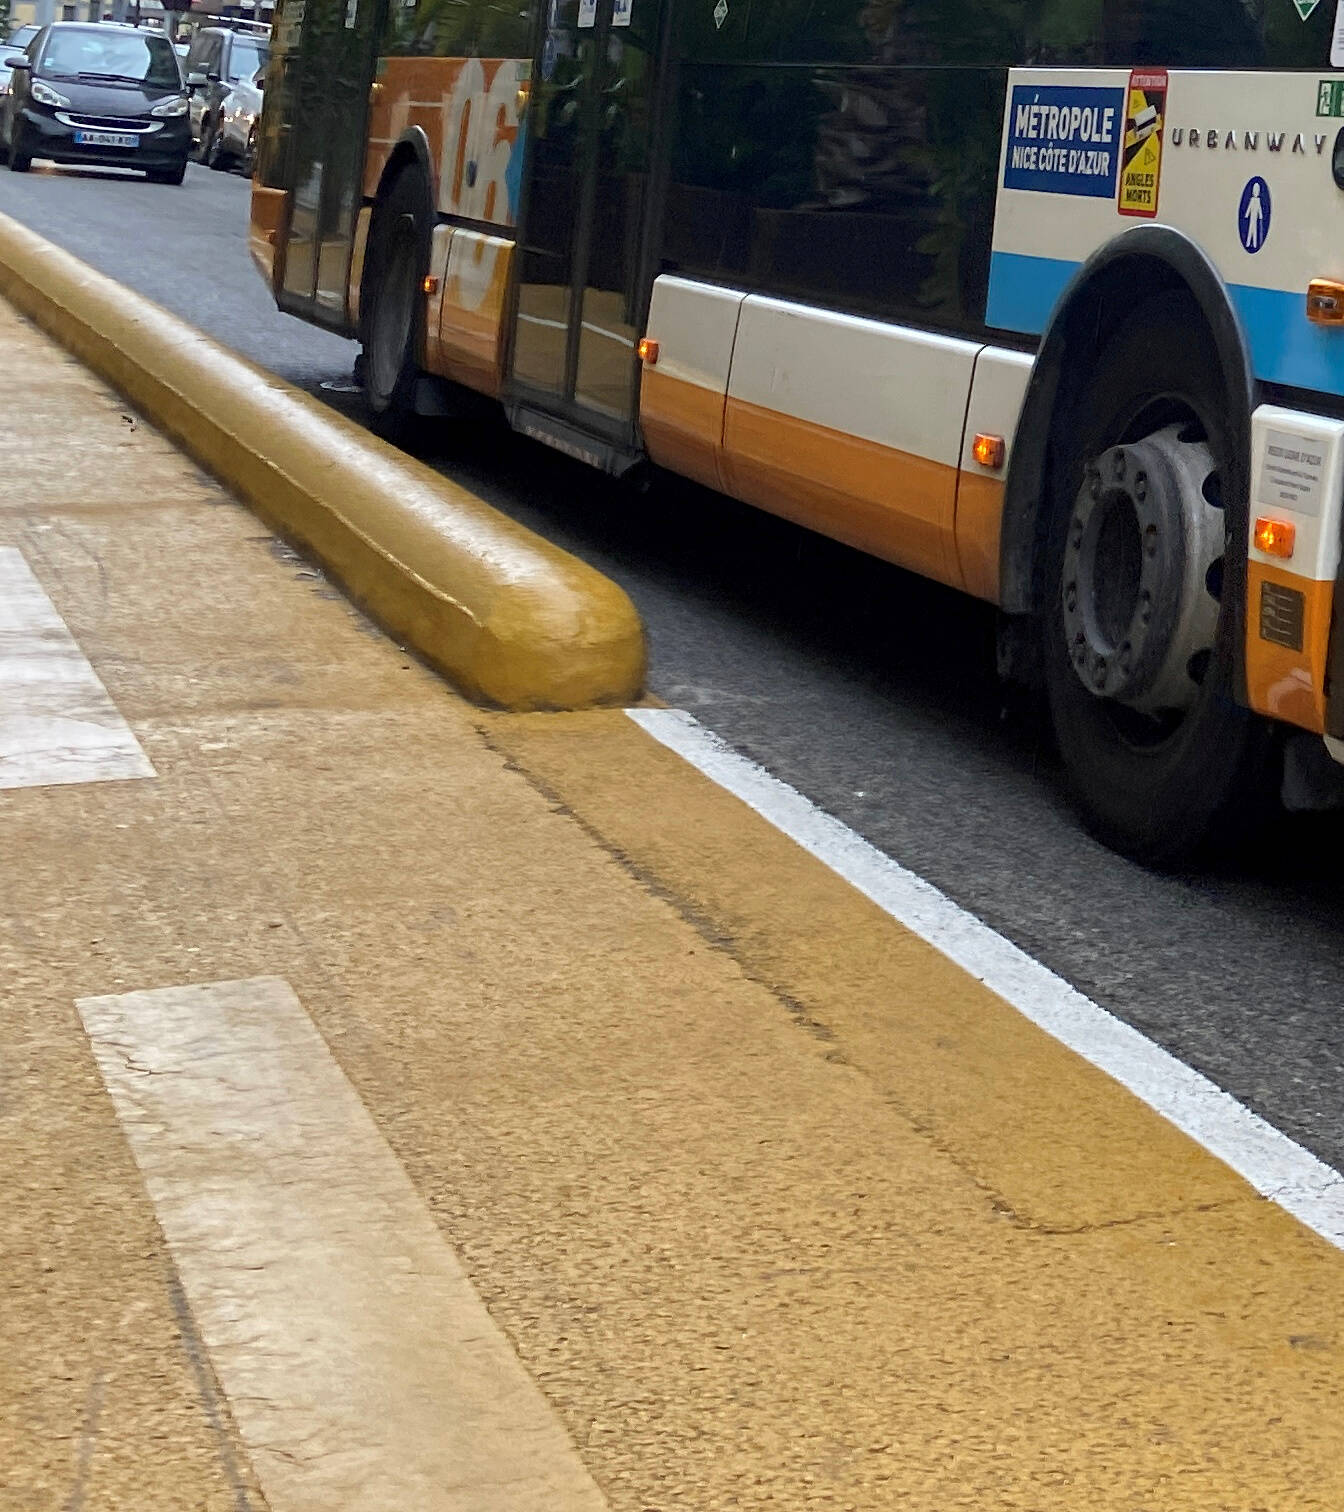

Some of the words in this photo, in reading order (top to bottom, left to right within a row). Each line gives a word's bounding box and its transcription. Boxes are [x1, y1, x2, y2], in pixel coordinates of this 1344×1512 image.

[1015, 95, 1114, 143] MÉTROPOLE
[1171, 126, 1328, 157] URBANWAY
[1011, 144, 1037, 172] NICE
[1038, 140, 1067, 175] CÔTE
[1068, 148, 1111, 178] D'AZUR
[1125, 172, 1154, 187] ANGLES
[1126, 189, 1151, 204] MORTS
